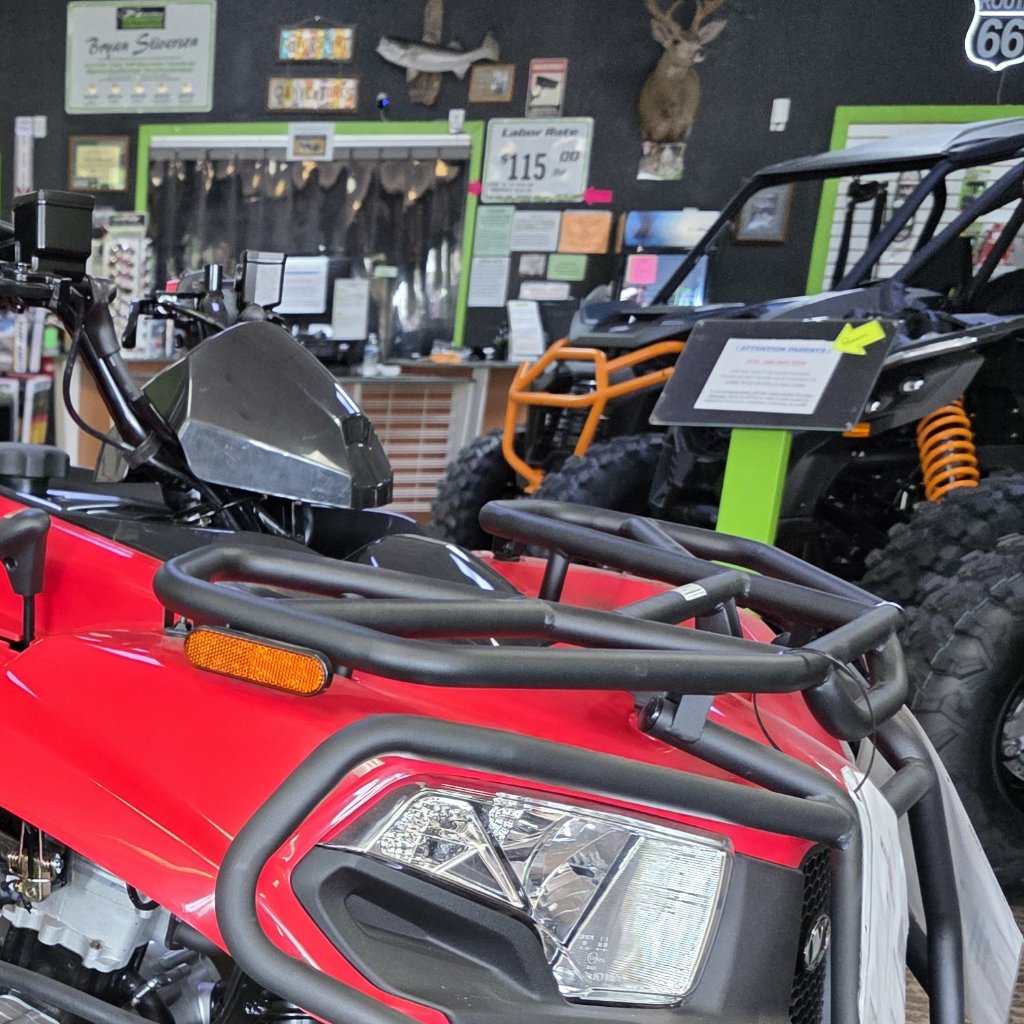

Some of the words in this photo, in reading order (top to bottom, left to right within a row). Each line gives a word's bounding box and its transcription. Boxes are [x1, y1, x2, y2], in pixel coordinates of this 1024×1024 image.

[977, 18, 1024, 58] 66
[501, 128, 541, 137] Labor
[545, 127, 578, 136] Rate
